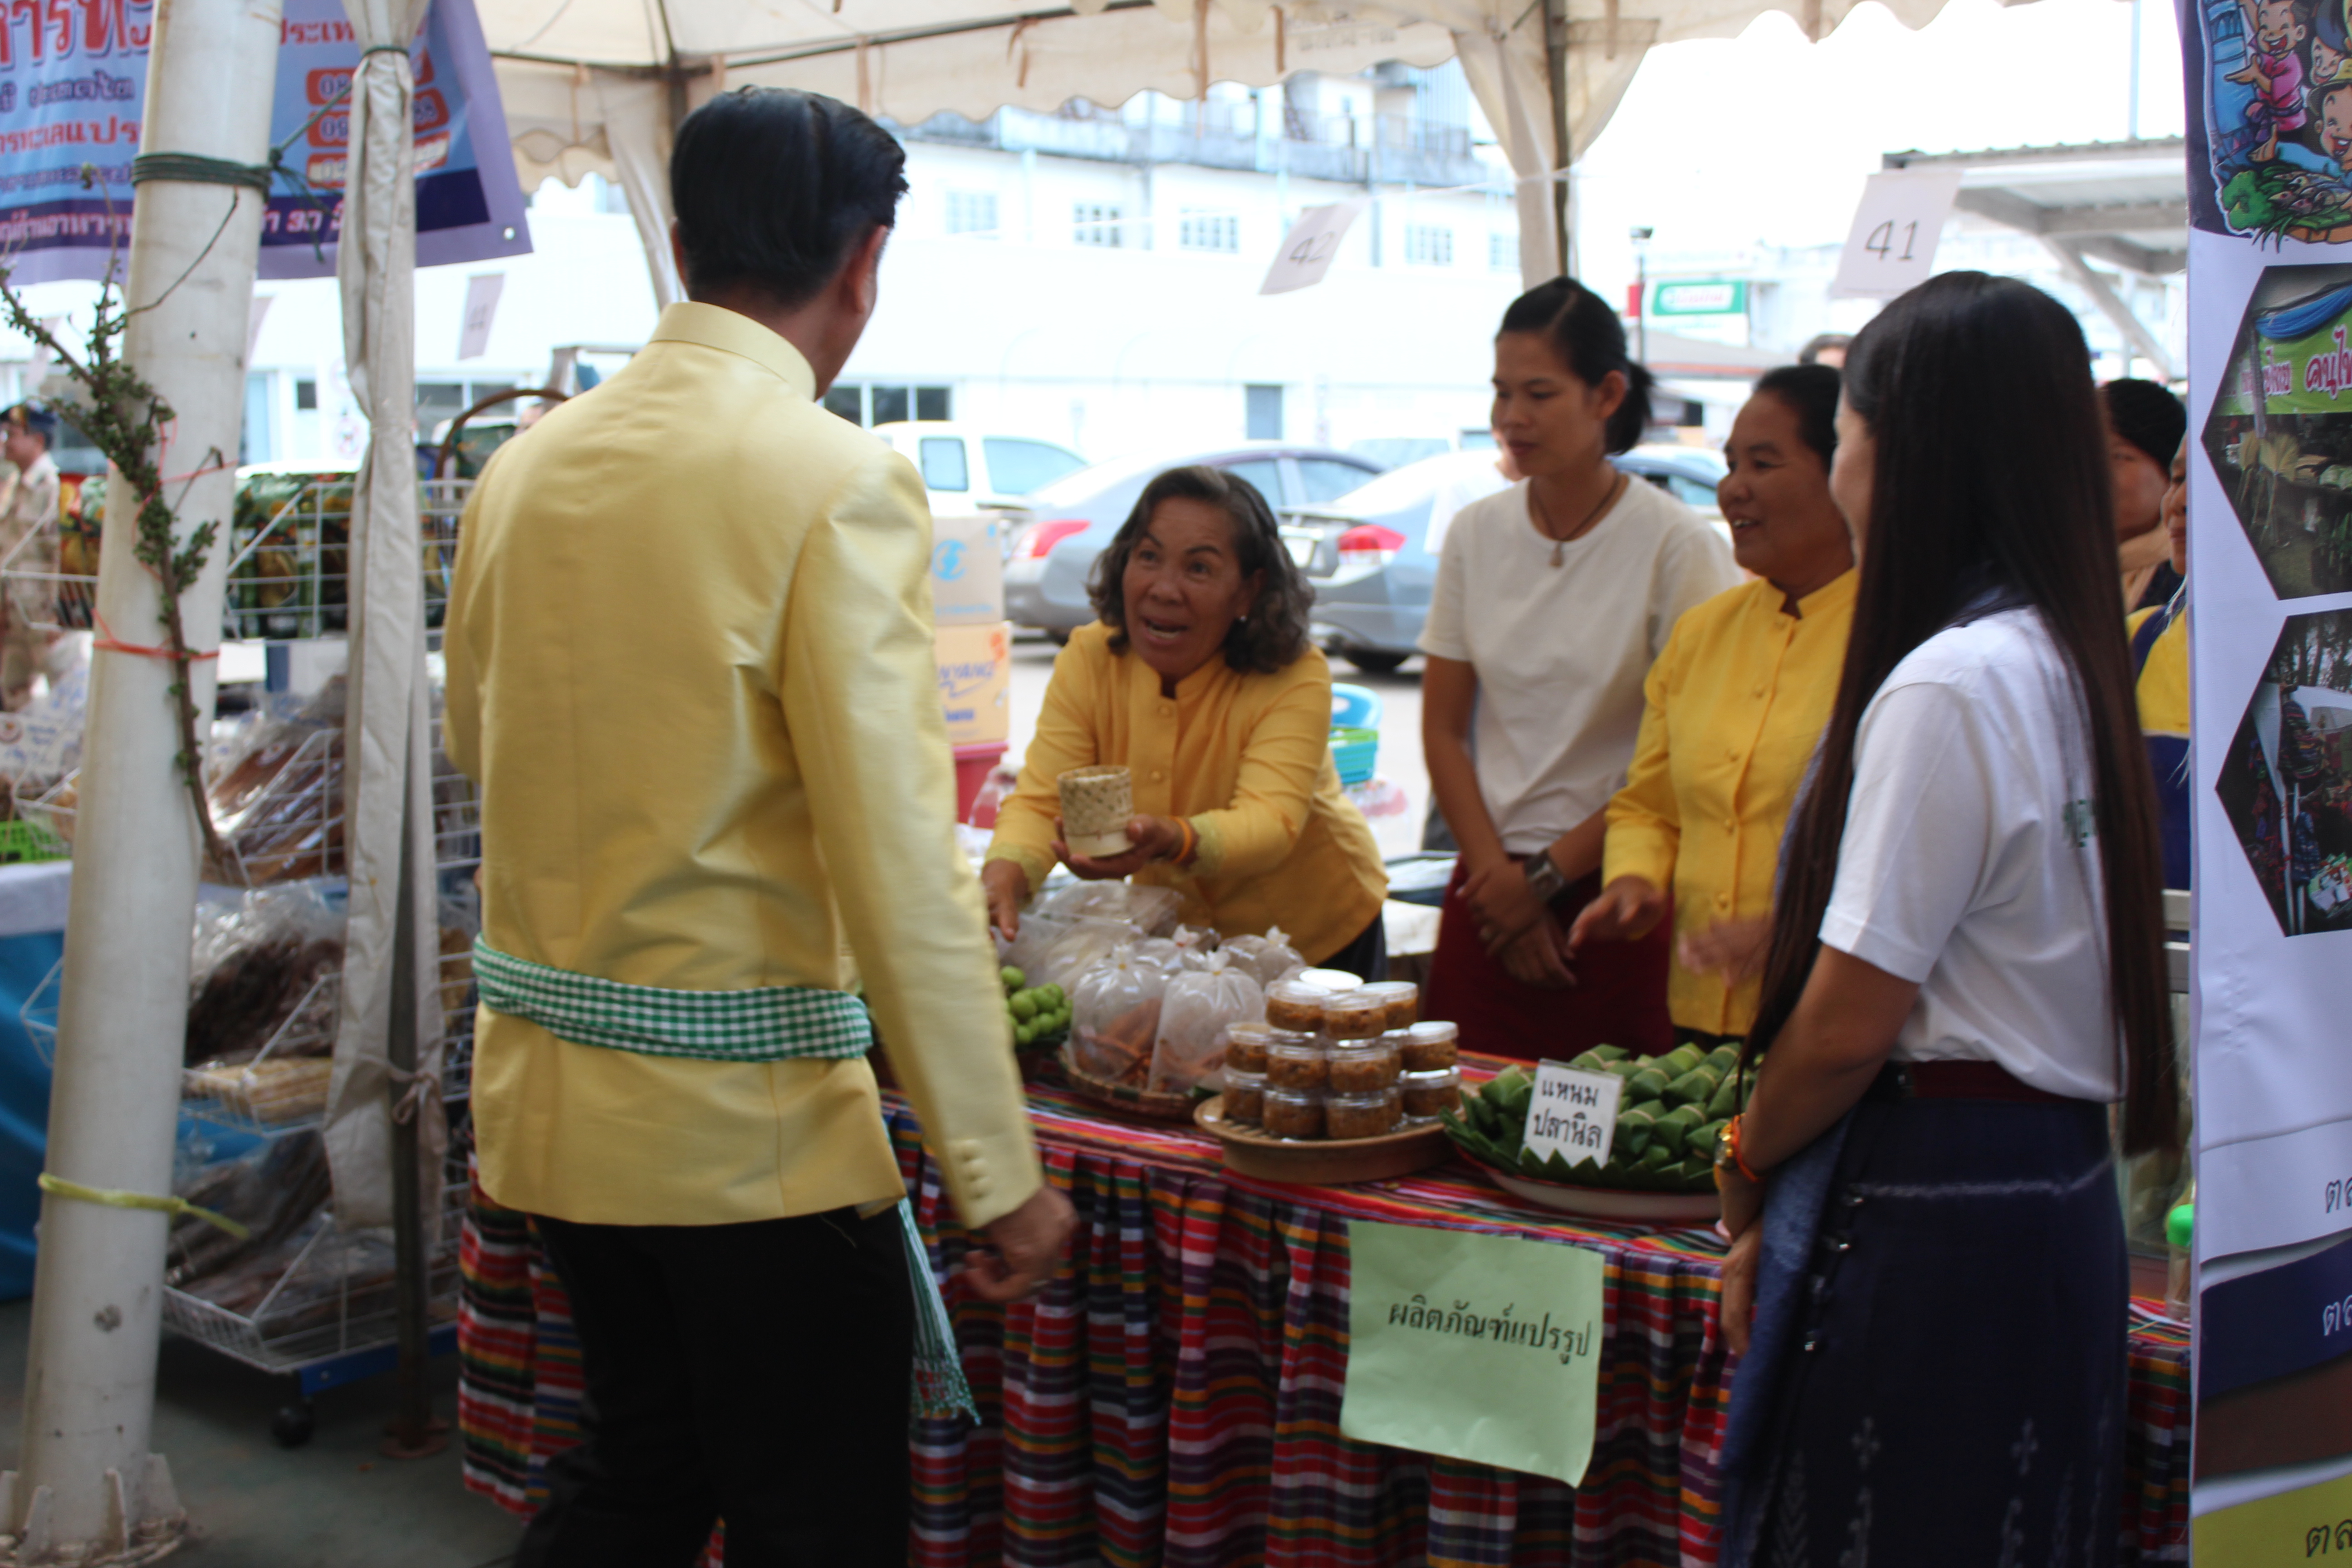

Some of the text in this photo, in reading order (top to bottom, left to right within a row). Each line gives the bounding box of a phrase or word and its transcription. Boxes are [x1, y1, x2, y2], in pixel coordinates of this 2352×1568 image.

[1289, 230, 1335, 266] 42
[1865, 219, 1918, 261] 41
[1542, 1079, 1599, 1107] แหนม
[1388, 1294, 1591, 1365] ผลิตภัณฑ์แปรรูป
